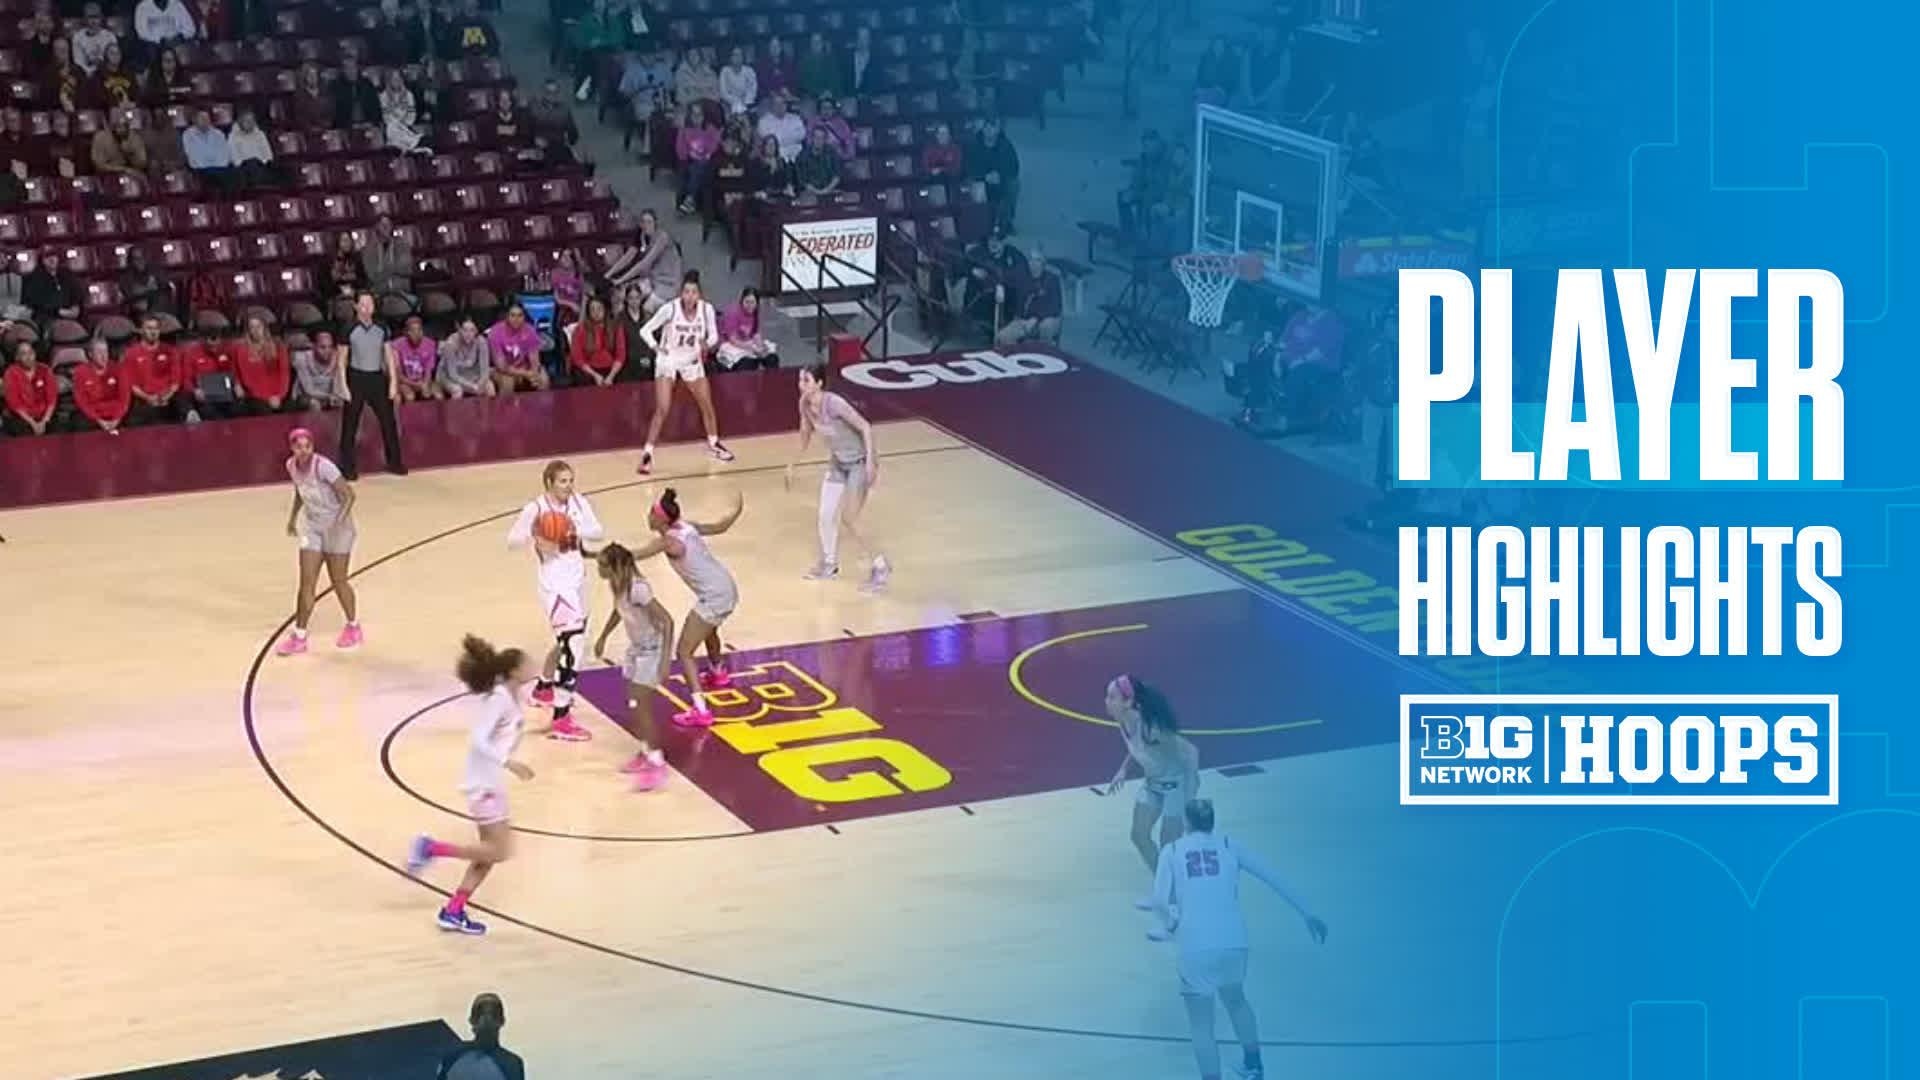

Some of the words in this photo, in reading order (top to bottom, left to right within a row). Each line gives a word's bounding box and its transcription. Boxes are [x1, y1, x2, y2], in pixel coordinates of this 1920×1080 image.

[788, 232, 875, 255] FEDERATED
[678, 335, 696, 347] 14
[840, 350, 1069, 390] Cub
[1185, 848, 1220, 879] 25
